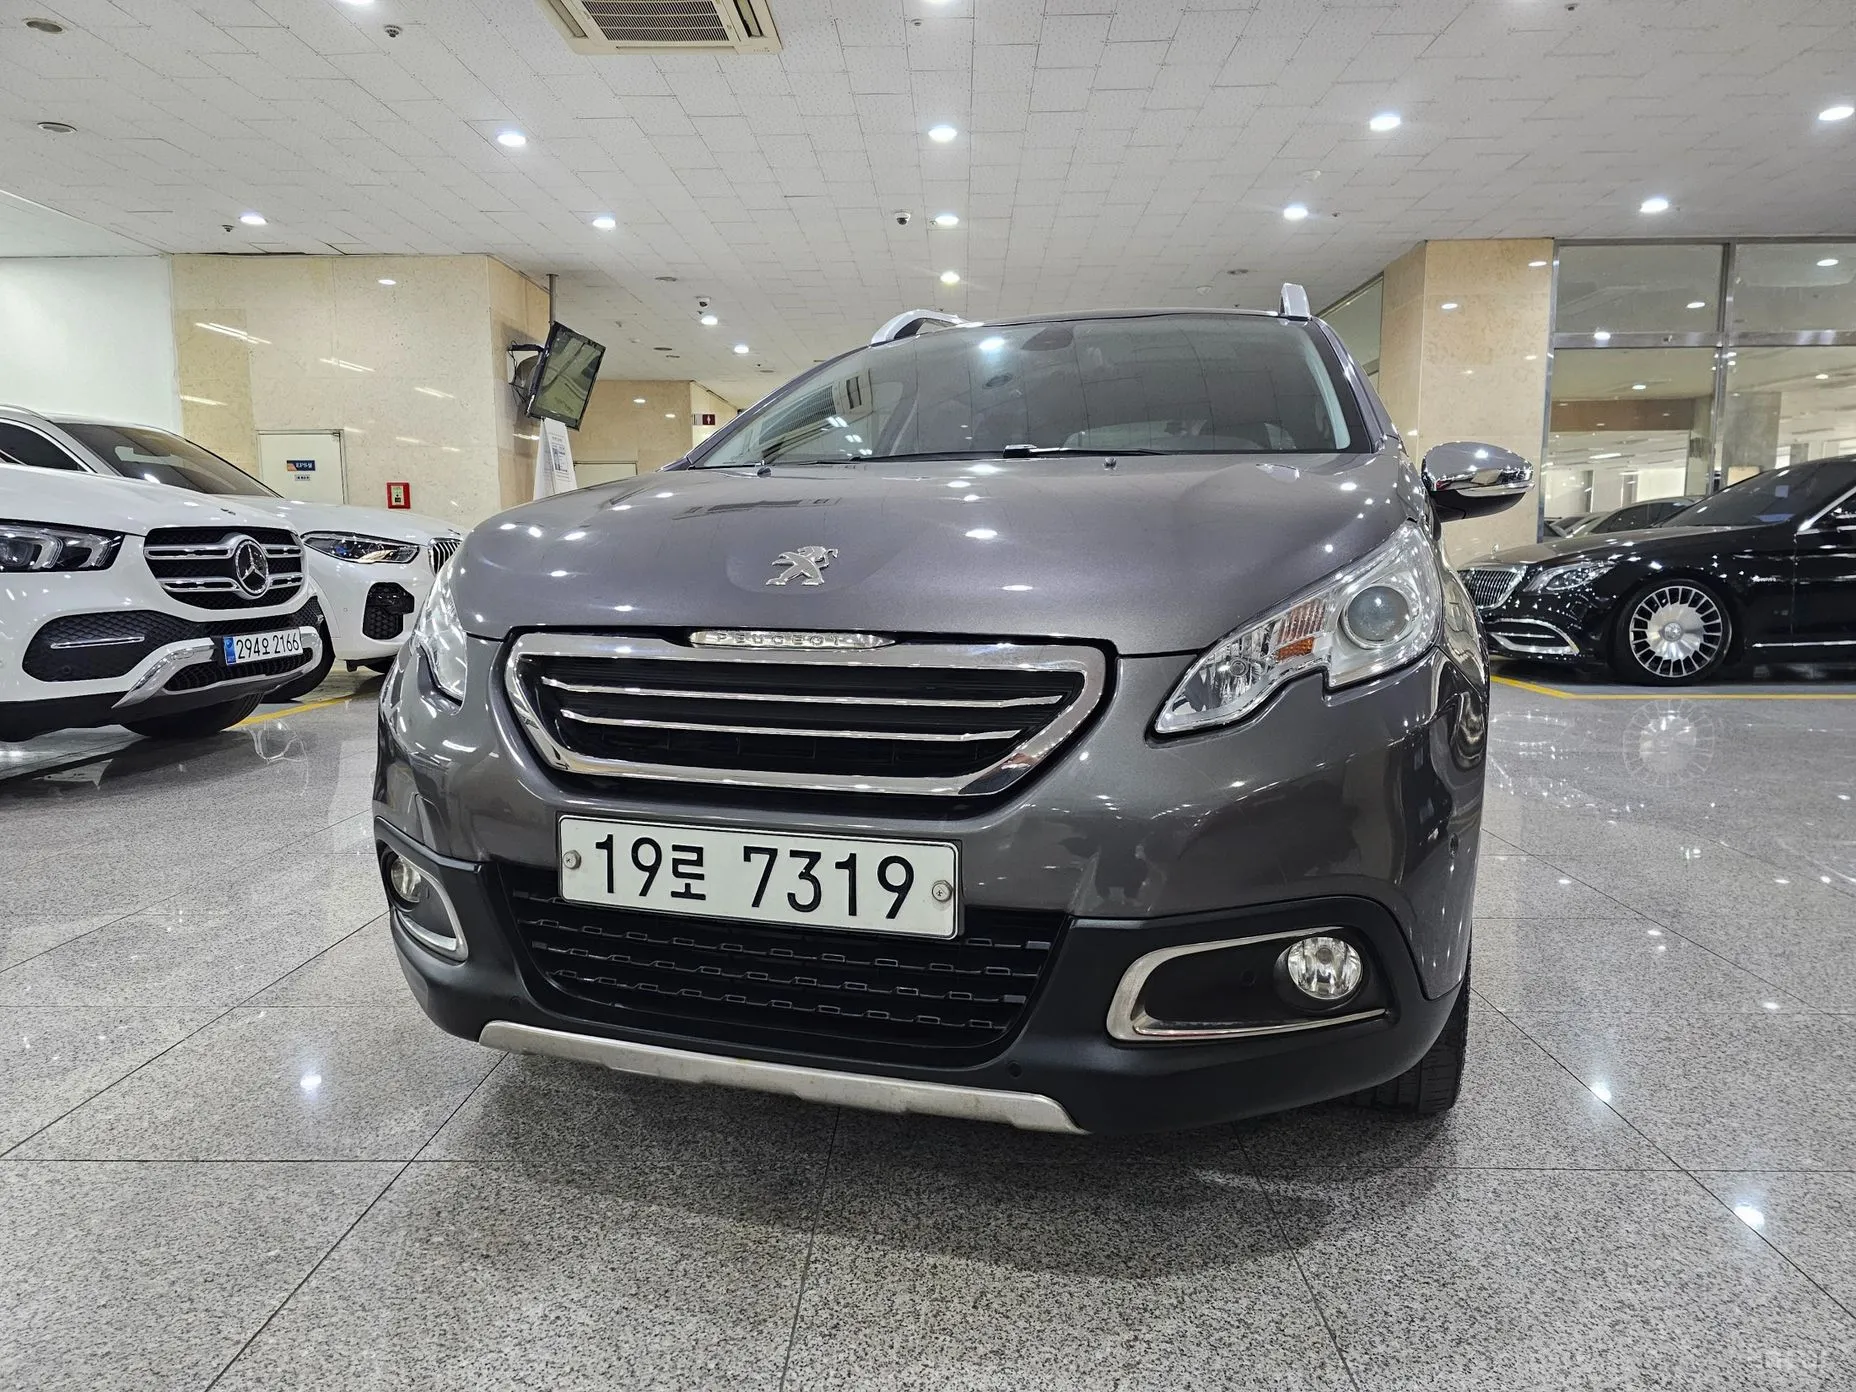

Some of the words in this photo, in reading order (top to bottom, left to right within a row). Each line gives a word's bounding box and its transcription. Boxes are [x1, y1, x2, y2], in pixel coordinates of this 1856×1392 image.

[236, 637, 271, 659] 294오
[272, 633, 300, 654] 2166
[716, 632, 841, 646] PEUGEOT
[595, 833, 706, 901] 19로
[743, 846, 915, 919] 7319
